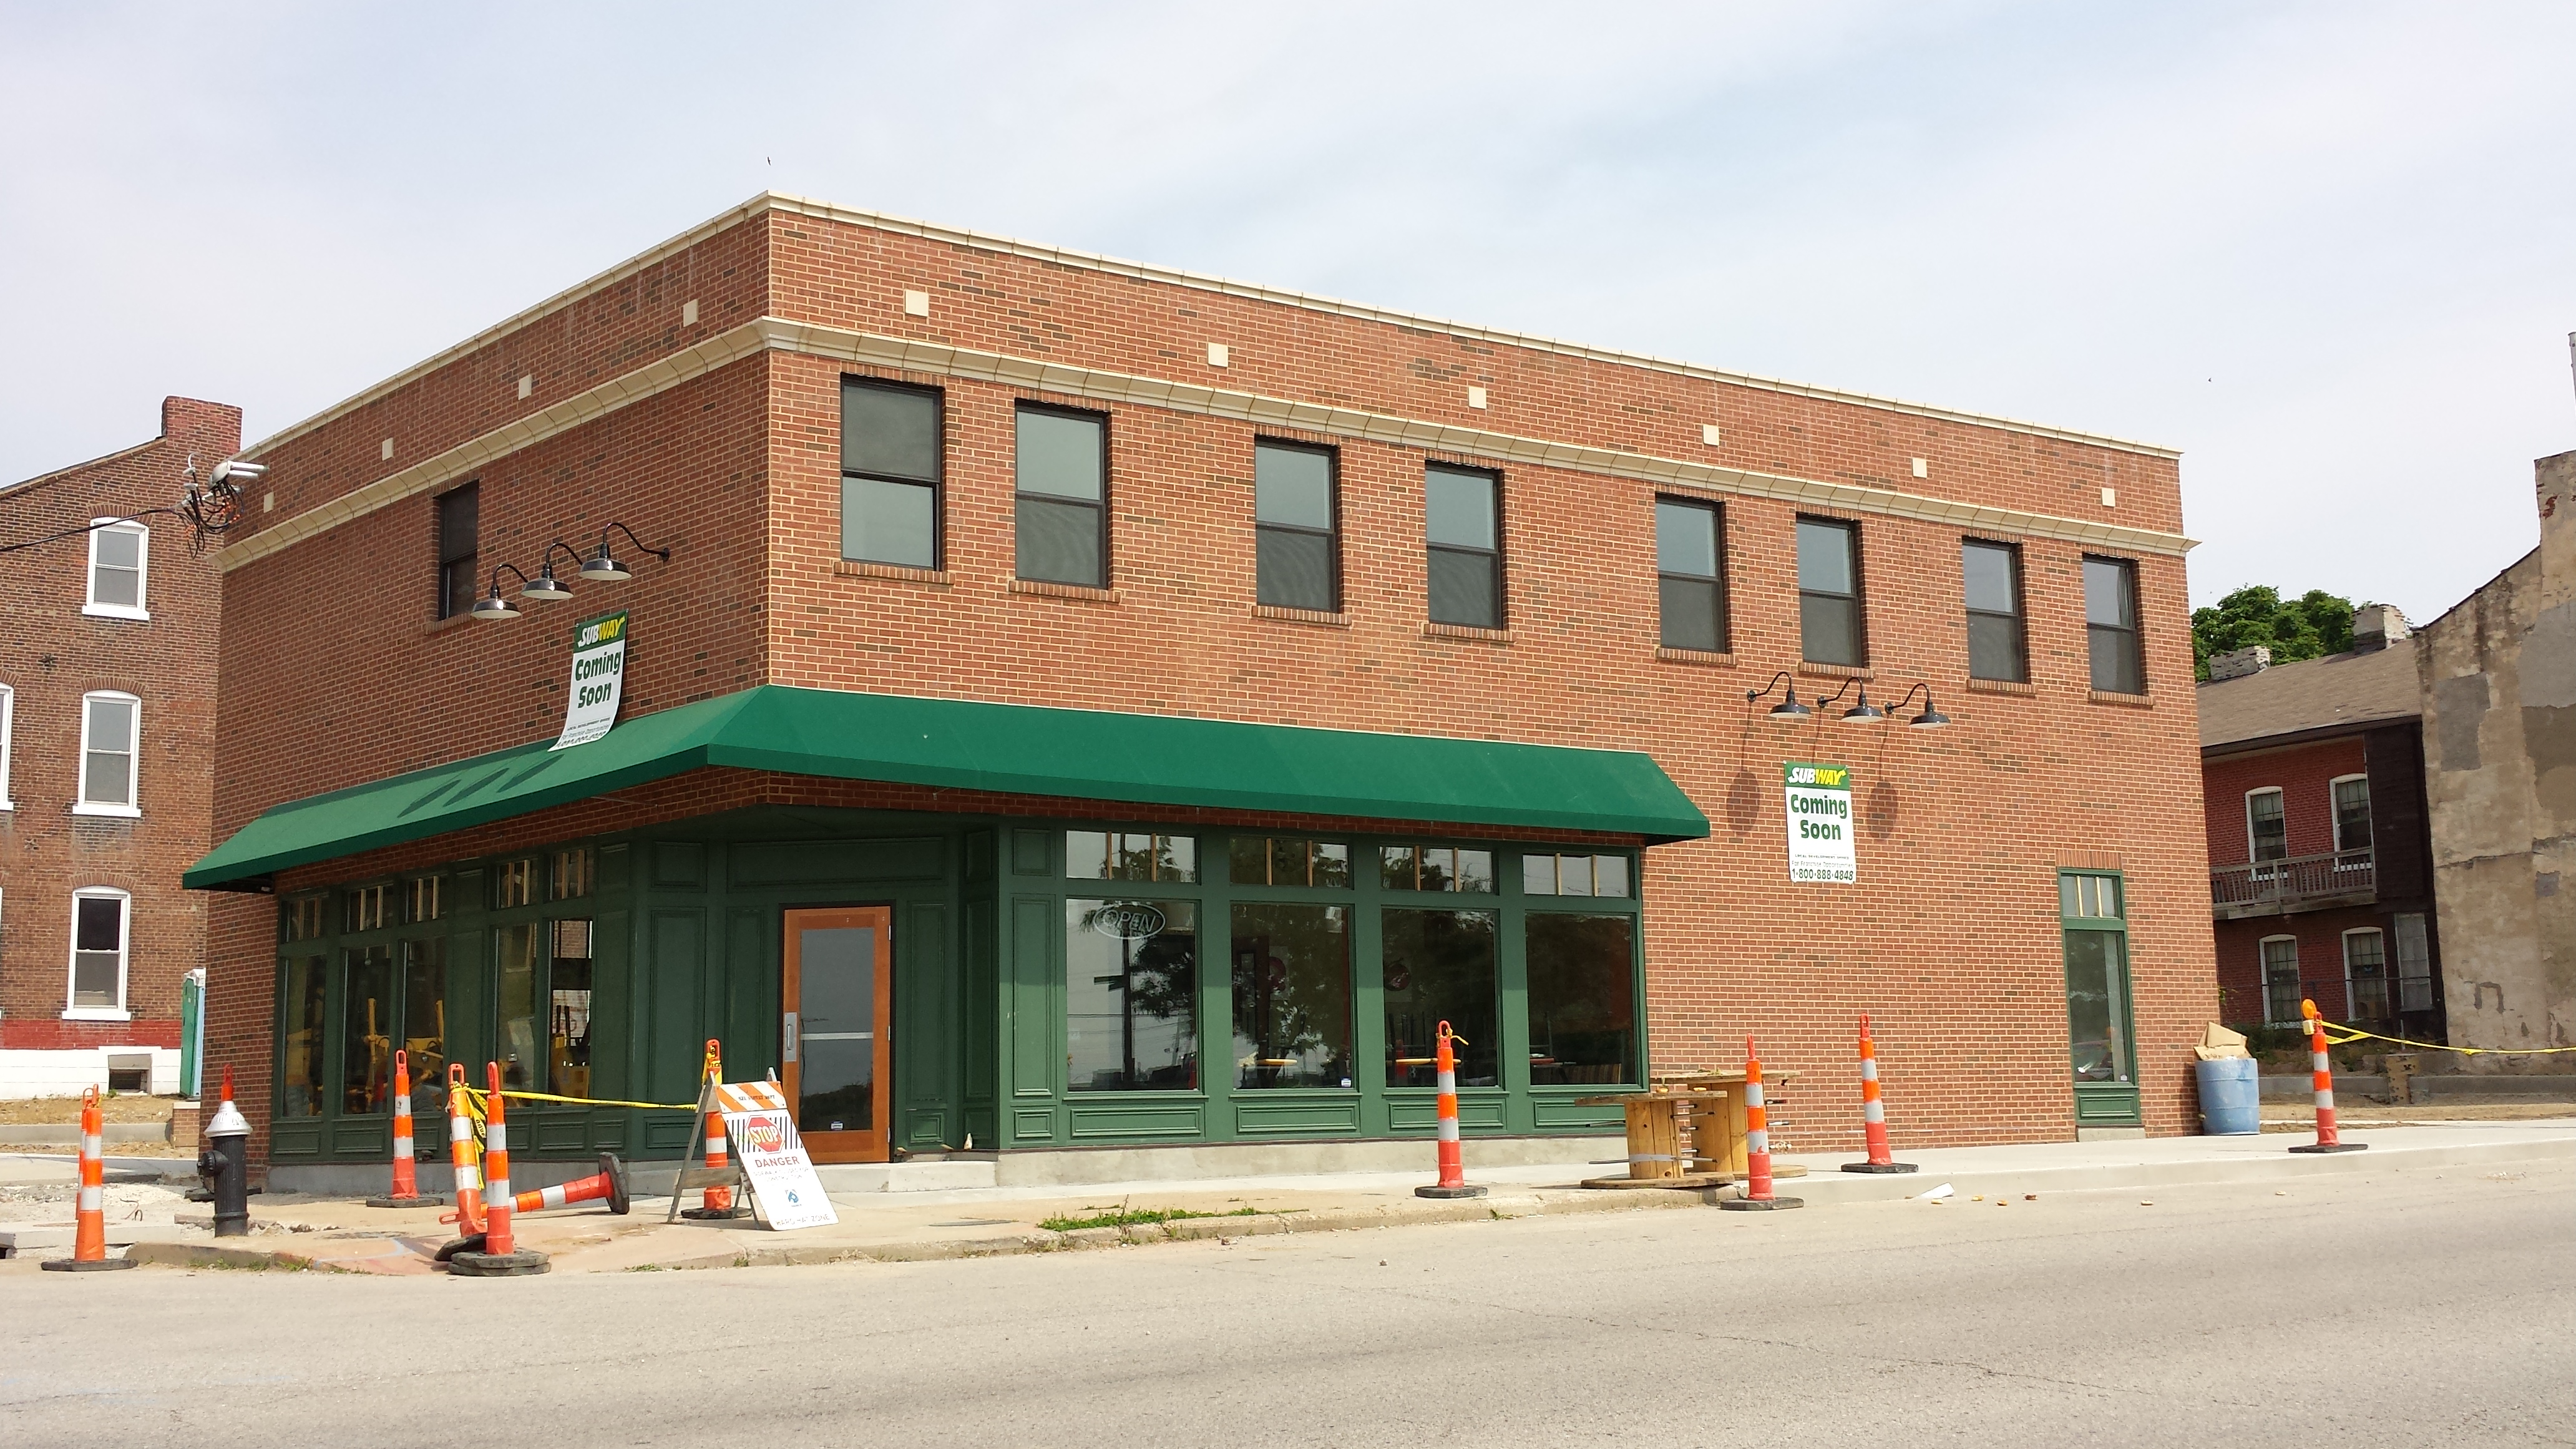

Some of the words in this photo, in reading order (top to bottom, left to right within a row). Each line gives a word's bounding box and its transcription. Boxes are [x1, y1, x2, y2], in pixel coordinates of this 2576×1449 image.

[578, 616, 625, 648] SUBWAY
[575, 651, 622, 681] Coming
[578, 682, 612, 708] Soon
[1787, 767, 1846, 786] SUBWAY
[1790, 794, 1847, 819] Coming
[1800, 819, 1841, 840] Soon
[1103, 909, 1156, 932] OPEN
[749, 1125, 779, 1143] STOP
[754, 1156, 800, 1168] DANGER
